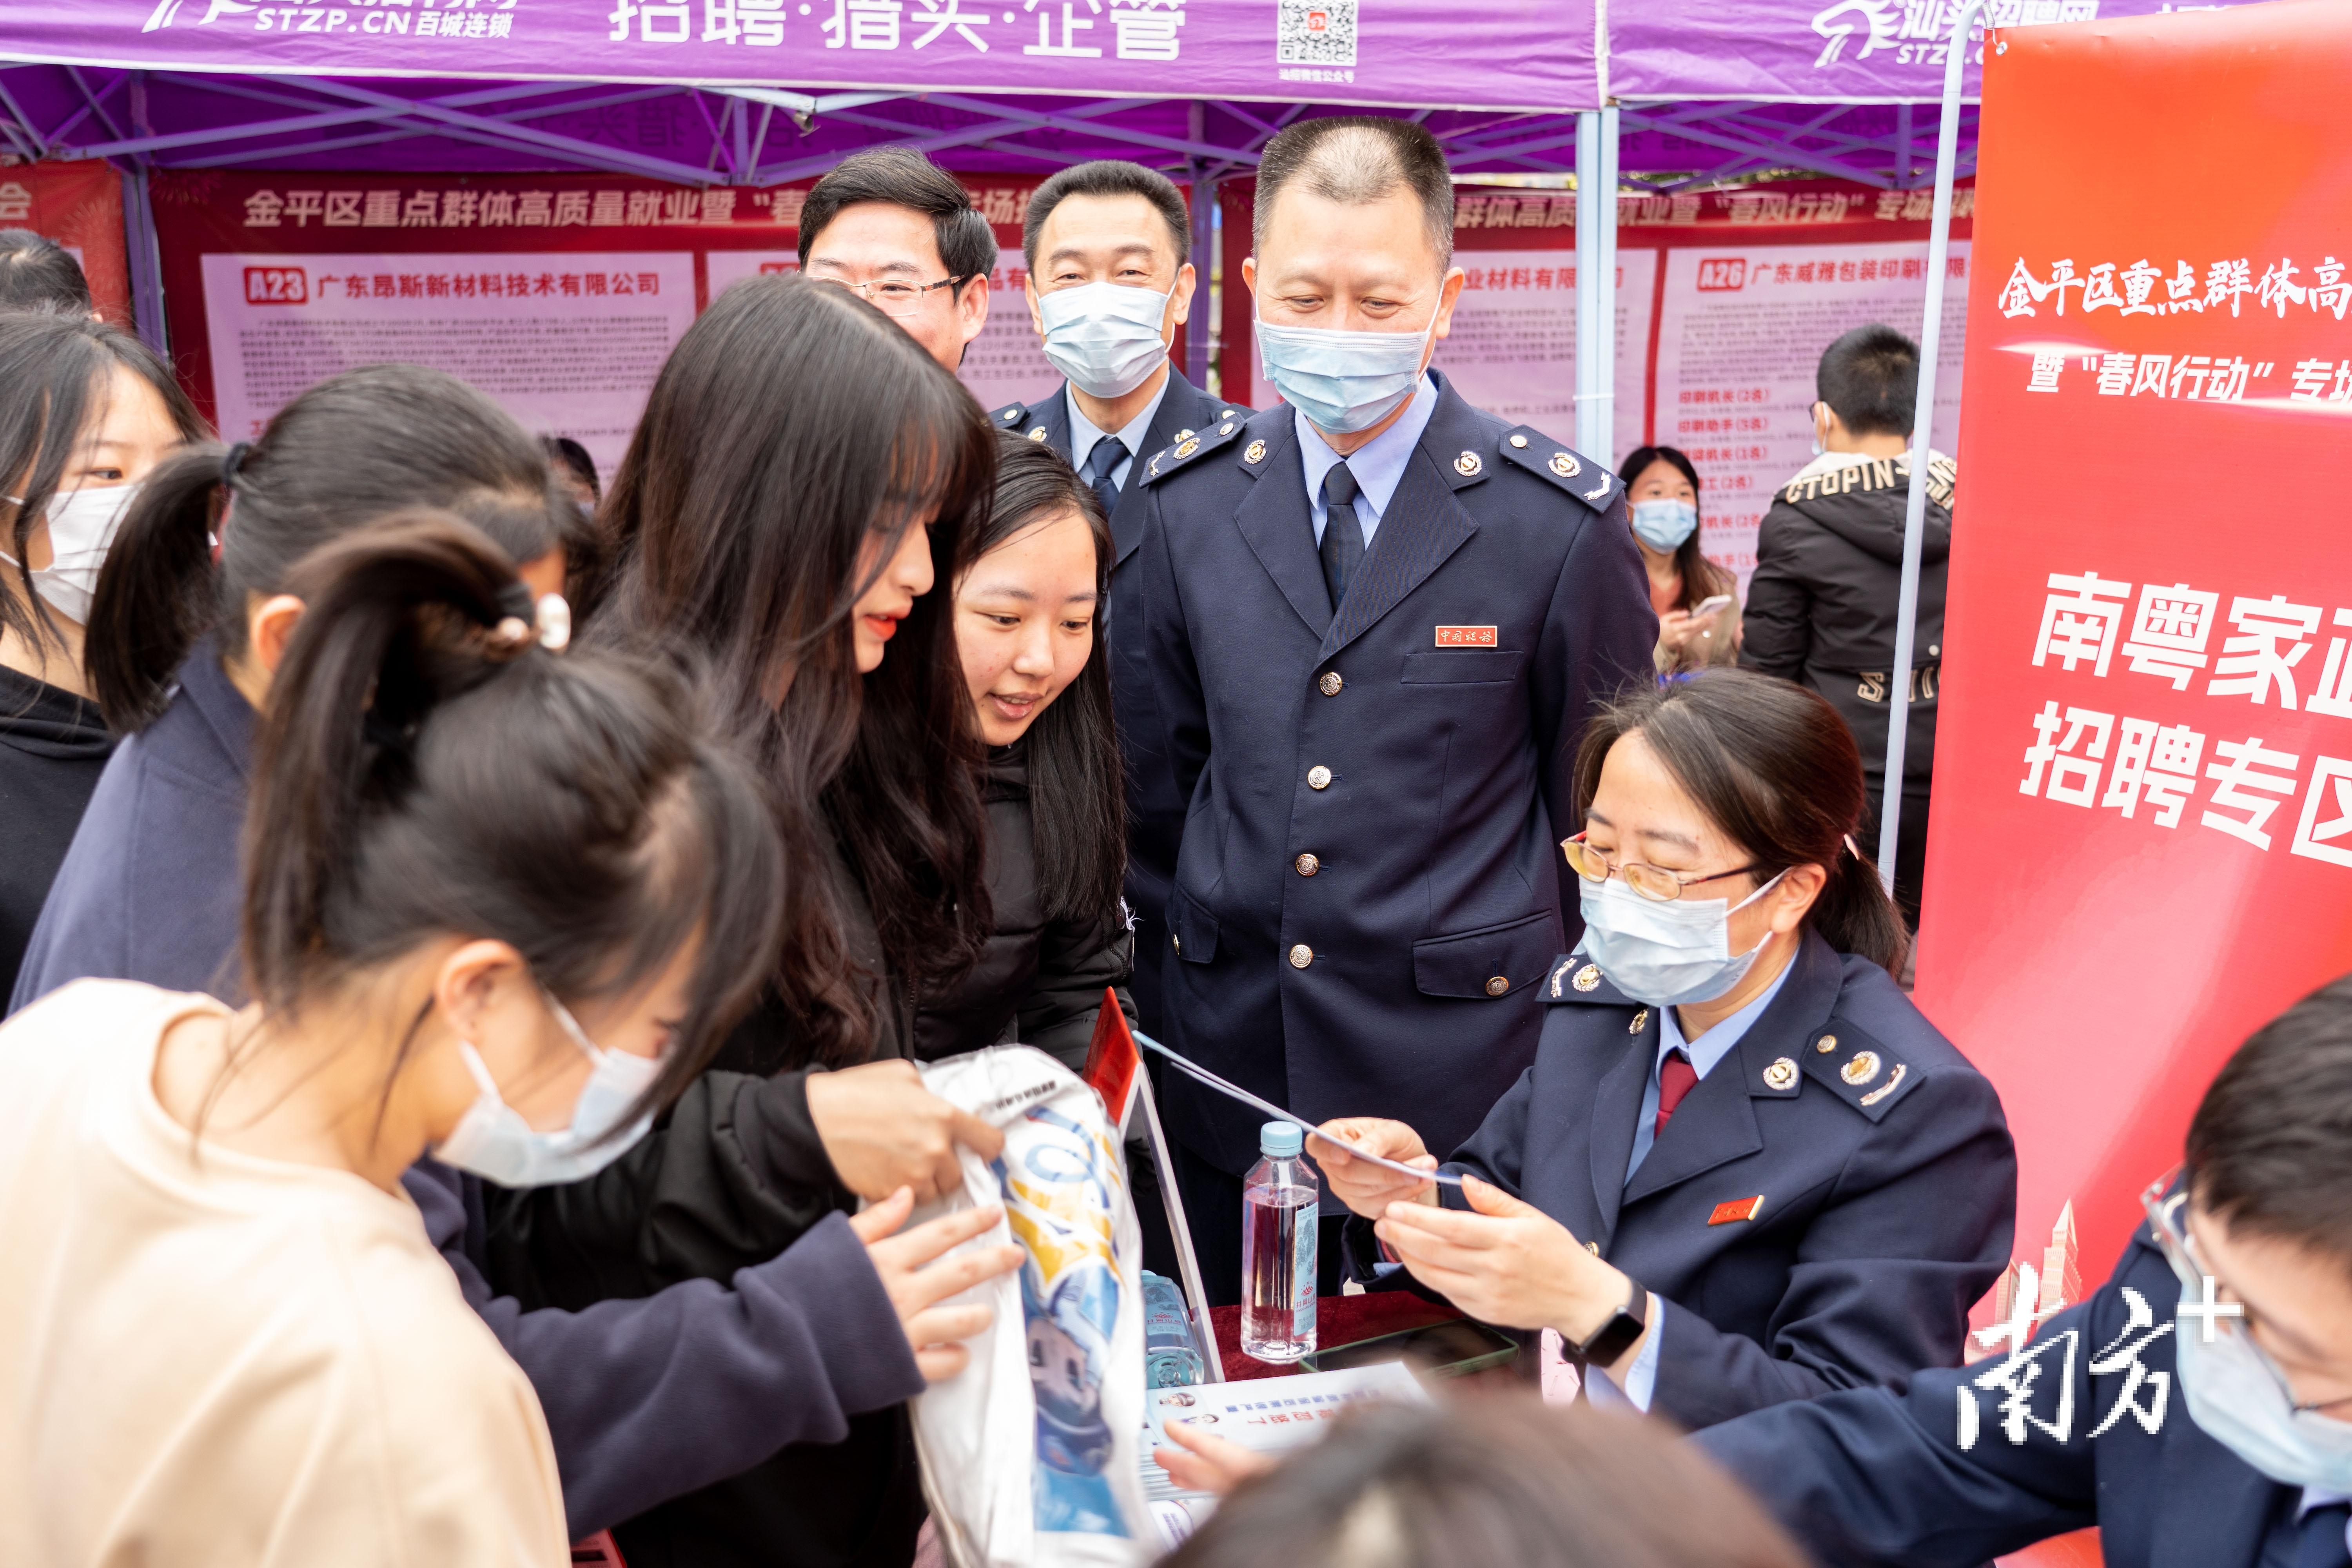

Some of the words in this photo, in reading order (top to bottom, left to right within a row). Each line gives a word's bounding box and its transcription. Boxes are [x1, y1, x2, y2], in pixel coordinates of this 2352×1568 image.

[254, 8, 410, 34] STZP.CN
[415, 11, 514, 38] 百城连锁
[248, 270, 305, 301] A23
[317, 272, 660, 299] 广东昂斯新材料技术有限公司
[2019, 700, 2352, 868] 招聘专区
